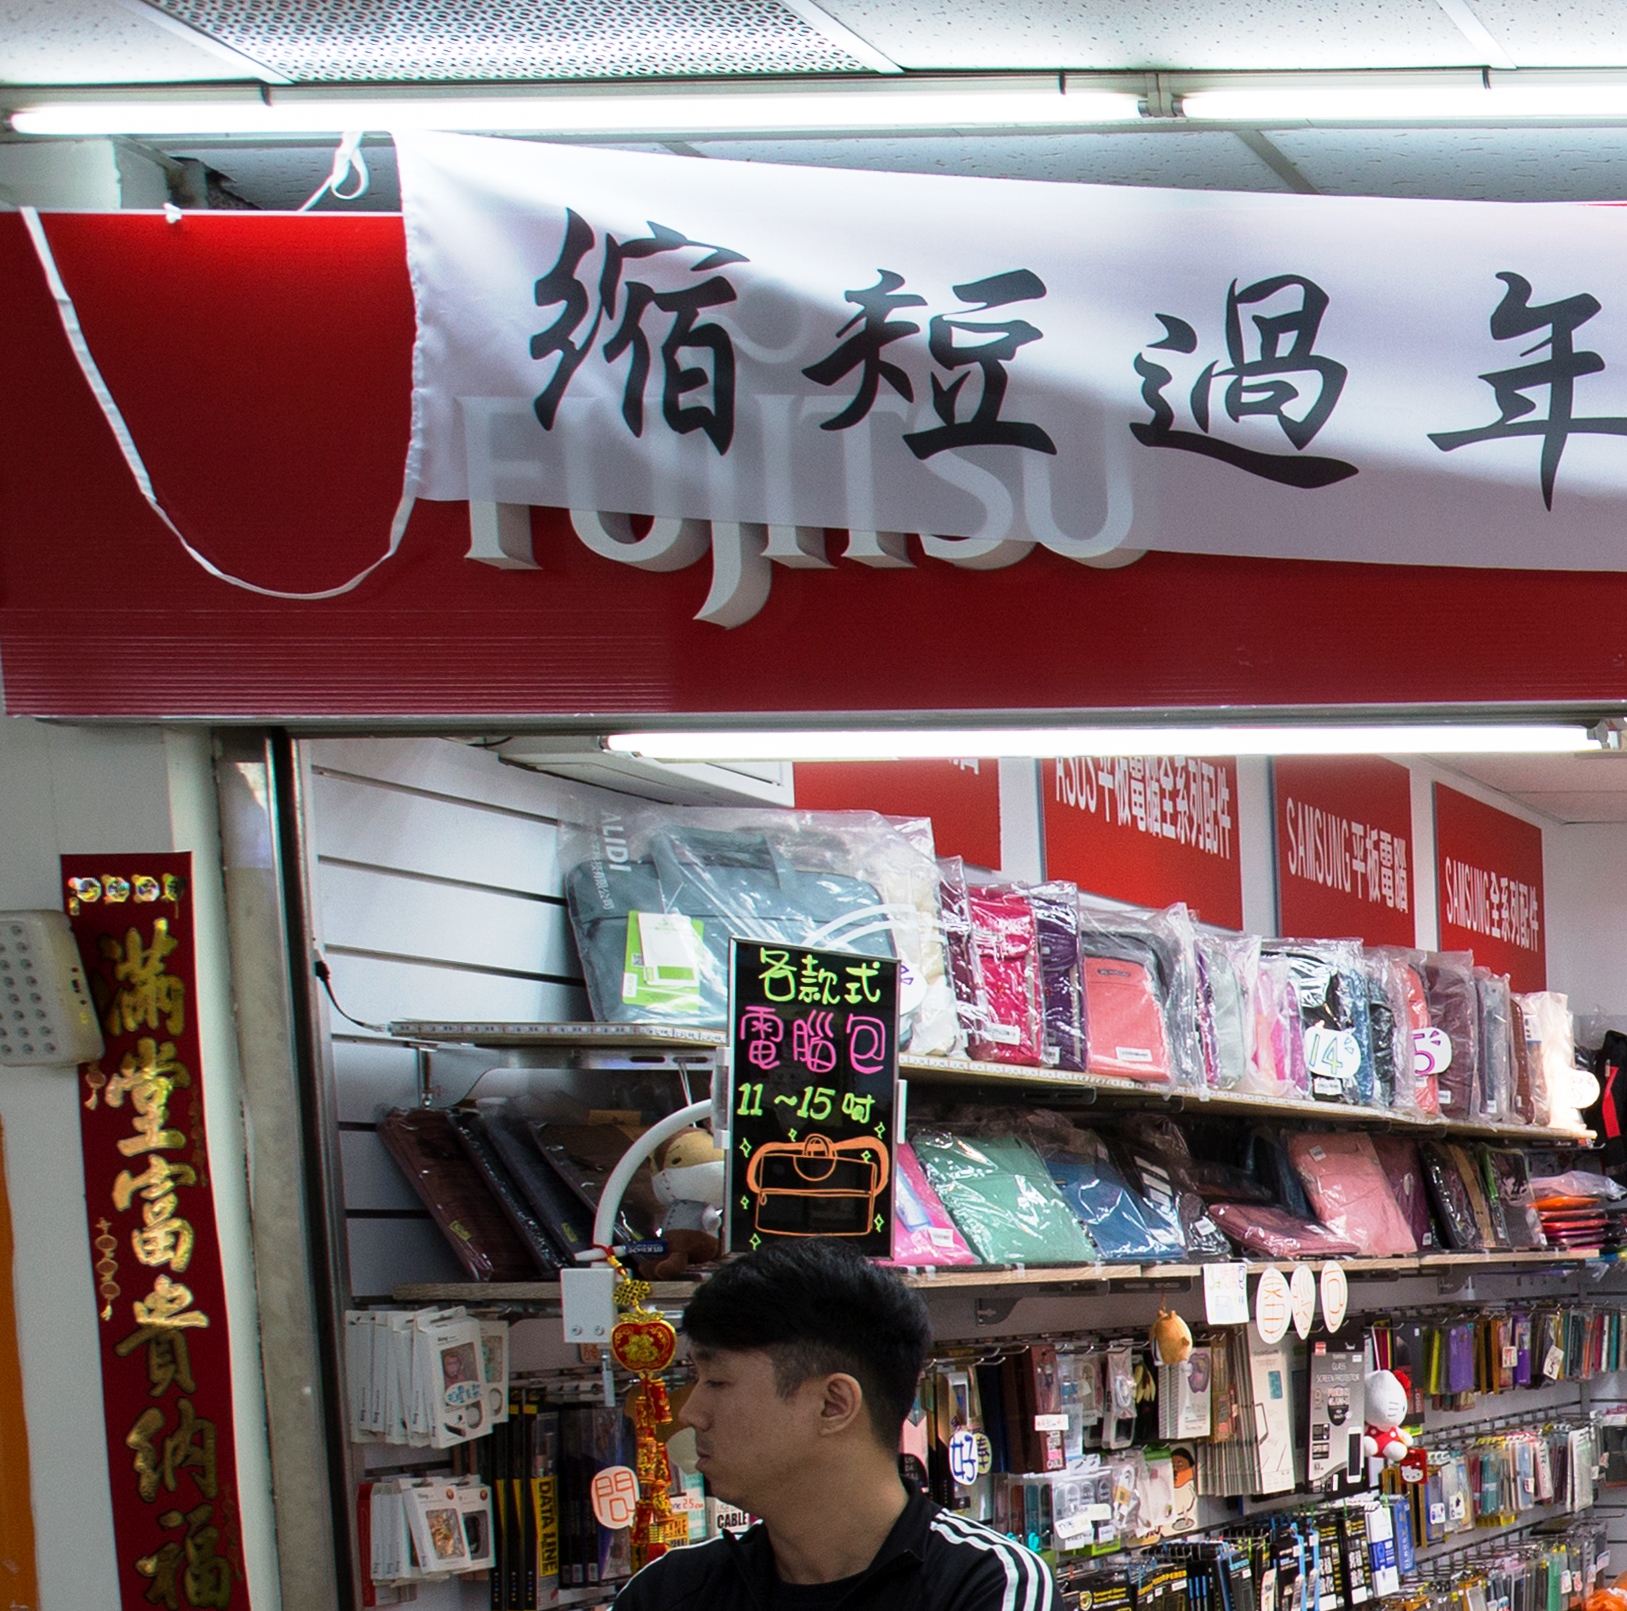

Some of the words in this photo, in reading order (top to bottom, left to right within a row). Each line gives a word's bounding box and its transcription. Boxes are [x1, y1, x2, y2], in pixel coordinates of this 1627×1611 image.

[759, 949, 882, 1005] 各款式
[740, 1012, 888, 1074] 電腦包
[537, 1482, 556, 1532] DATA
[537, 1534, 558, 1576] LINE
